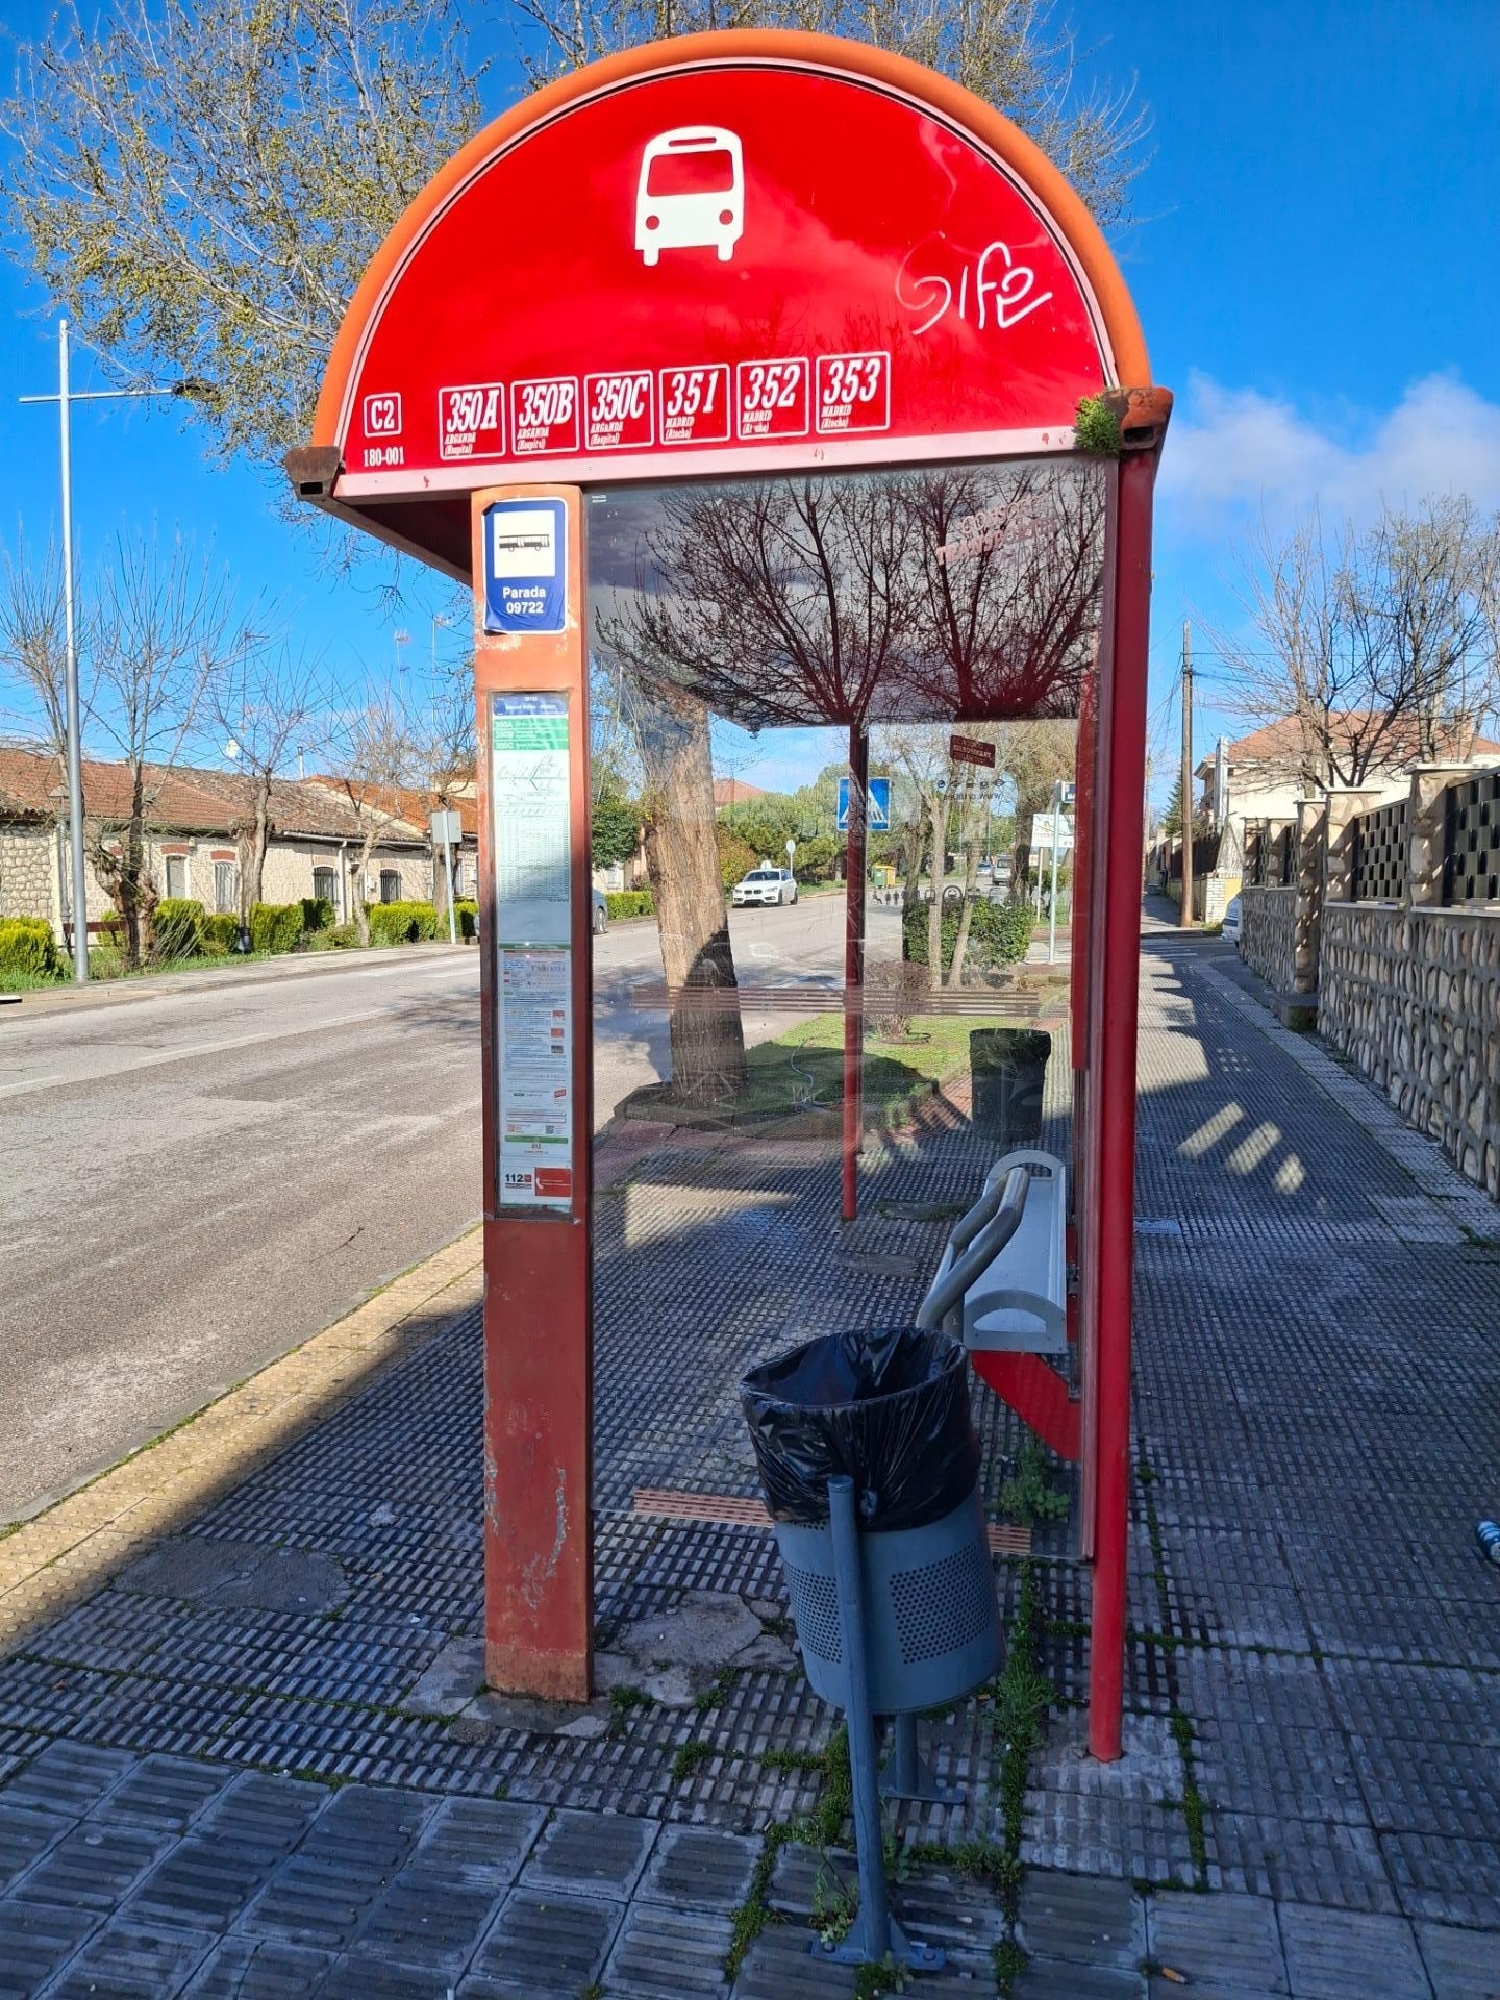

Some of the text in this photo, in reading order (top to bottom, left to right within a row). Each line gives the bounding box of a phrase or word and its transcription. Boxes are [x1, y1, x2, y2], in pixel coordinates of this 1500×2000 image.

[744, 364, 801, 409] 352
[823, 358, 881, 404] 353
[591, 376, 649, 421] 350C
[667, 370, 719, 416] 351
[446, 390, 500, 432] 350A
[518, 383, 575, 427] 350B
[821, 404, 852, 417] MADRID
[371, 399, 395, 430] C2
[665, 415, 695, 428] MADRID
[742, 409, 773, 422] MADRID
[517, 426, 550, 440] ARGANDA
[742, 421, 770, 434] (Atcha)
[444, 432, 476, 445] ARGANDA
[364, 446, 405, 467] 180-001
[502, 585, 546, 599] Parada
[506, 601, 544, 614] 09722
[505, 1173, 524, 1182] 112
